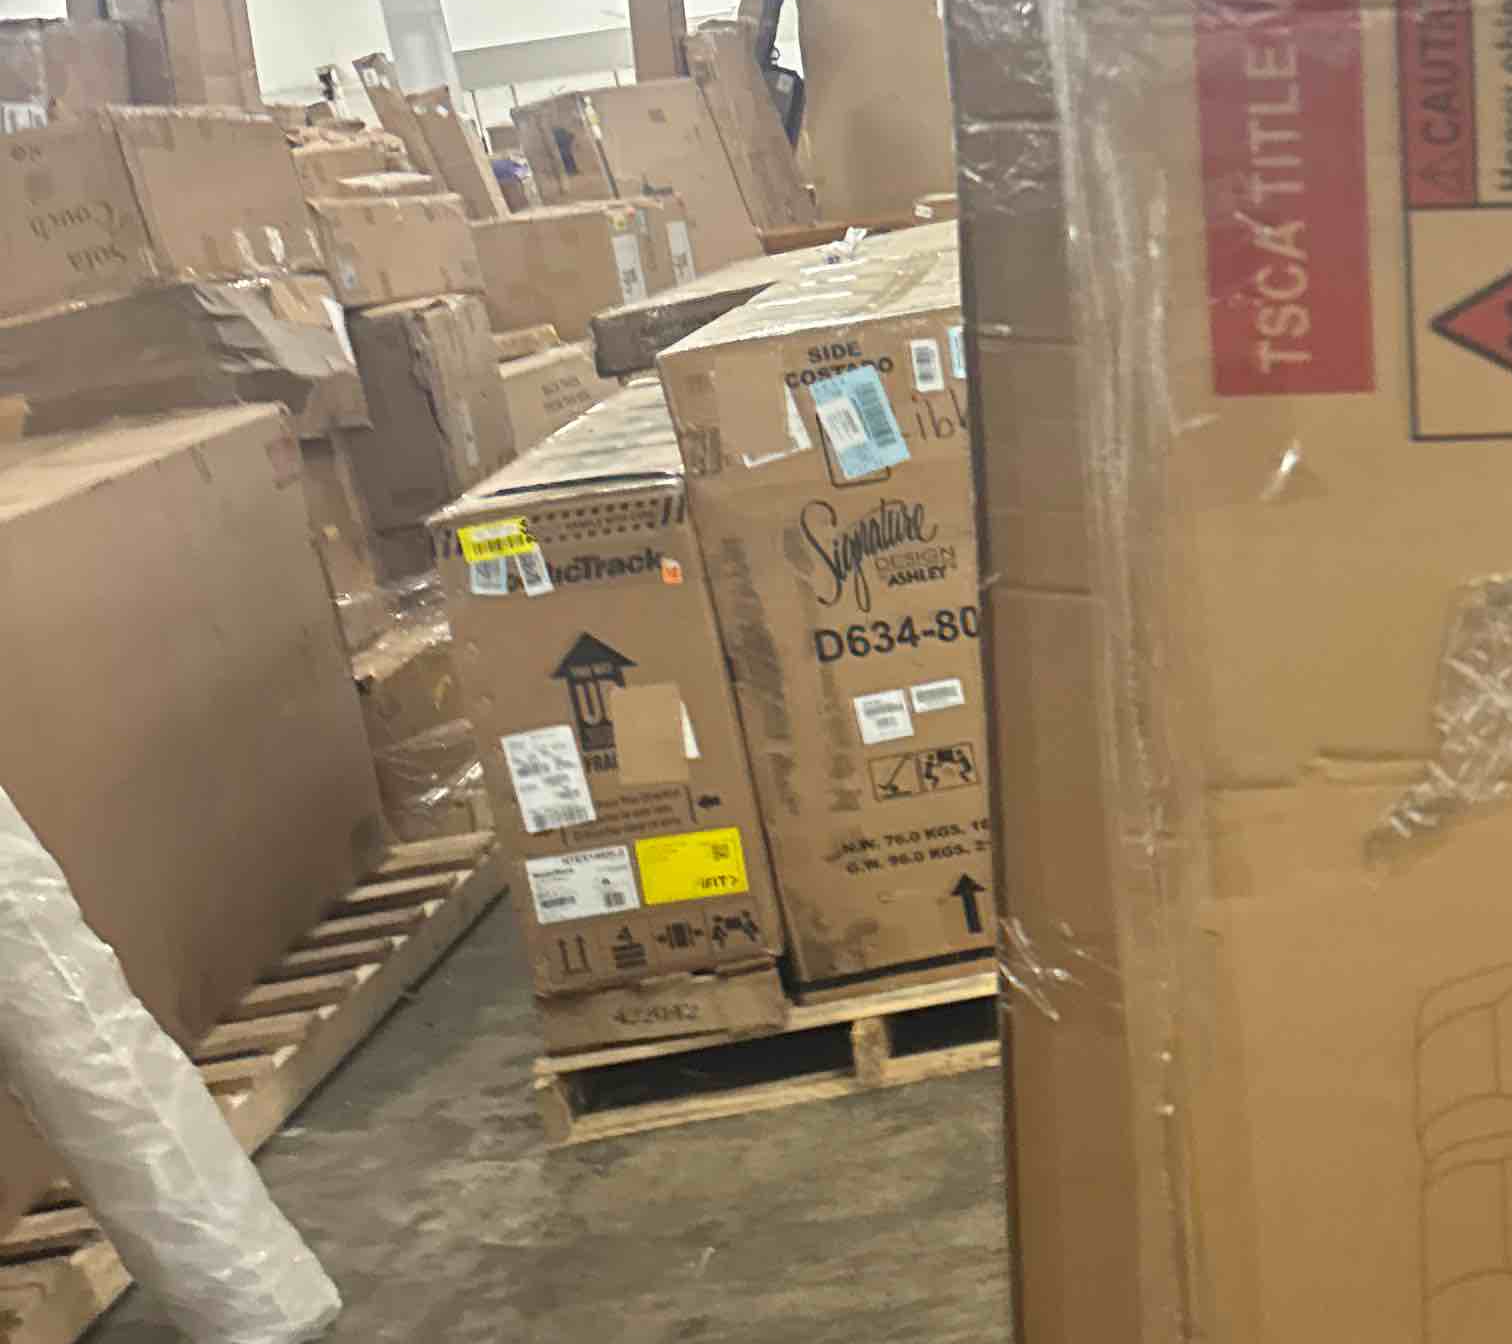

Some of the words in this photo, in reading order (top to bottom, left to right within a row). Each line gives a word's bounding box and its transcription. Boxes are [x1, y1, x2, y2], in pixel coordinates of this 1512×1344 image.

[1246, 44, 1305, 205] TITLE
[809, 342, 861, 364] SIDE
[1253, 220, 1311, 374] TSCA
[801, 497, 938, 613] Signature
